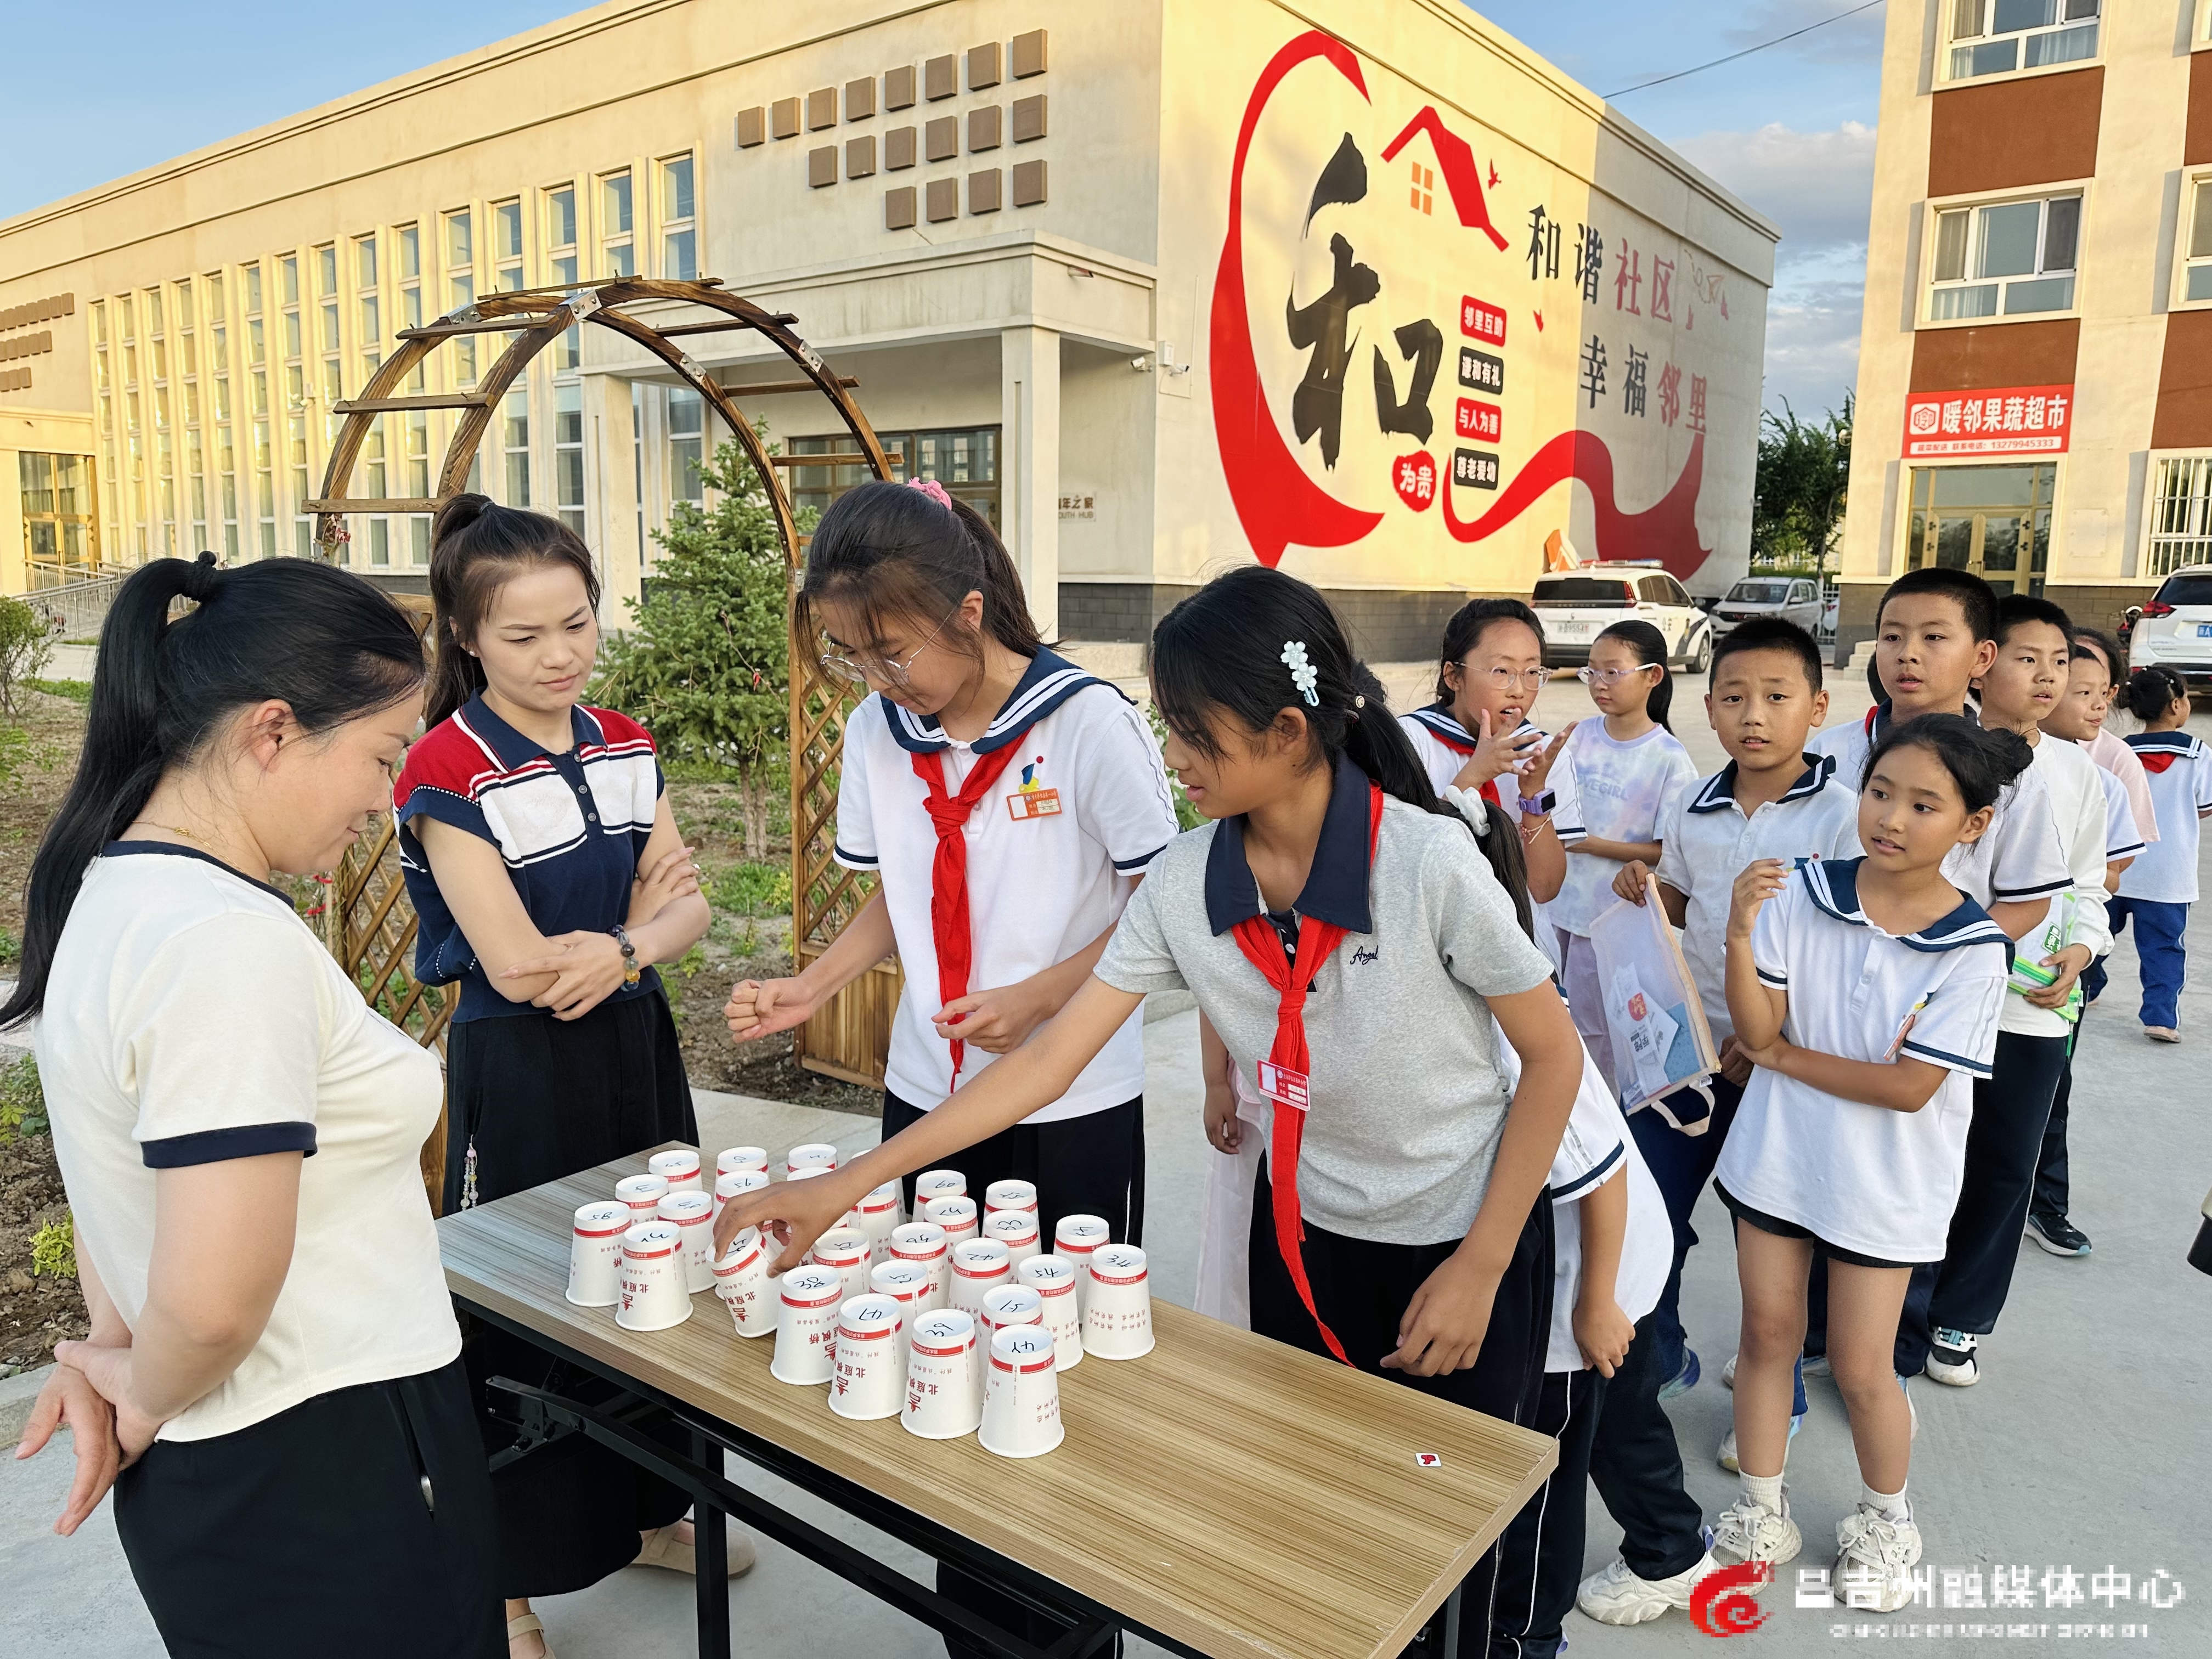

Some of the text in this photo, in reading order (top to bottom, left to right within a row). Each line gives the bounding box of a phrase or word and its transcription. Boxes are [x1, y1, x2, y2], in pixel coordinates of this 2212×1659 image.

[1526, 204, 1675, 323] 和谐社区
[1286, 132, 1443, 472] 和
[1464, 305, 1504, 338] 邻里互助
[1462, 355, 1501, 387] 谦和有礼
[1581, 335, 1707, 433] 幸福邻里
[1459, 406, 1499, 435] 与人为善
[1941, 394, 2068, 435] 暖邻果蔬超市
[1400, 461, 1435, 499] 为贵
[1457, 455, 1497, 483] 尊老爱幼
[589, 1211, 613, 1222] 58
[1034, 1268, 1059, 1278] 54
[1105, 1254, 1132, 1268] 34
[620, 1277, 649, 1294] 北庭枫
[793, 1276, 826, 1290] 38
[724, 1291, 756, 1306] 北庭枫
[858, 1307, 883, 1322] 47
[834, 1357, 866, 1379] 北庭枫
[906, 1374, 939, 1396] 北庭枫
